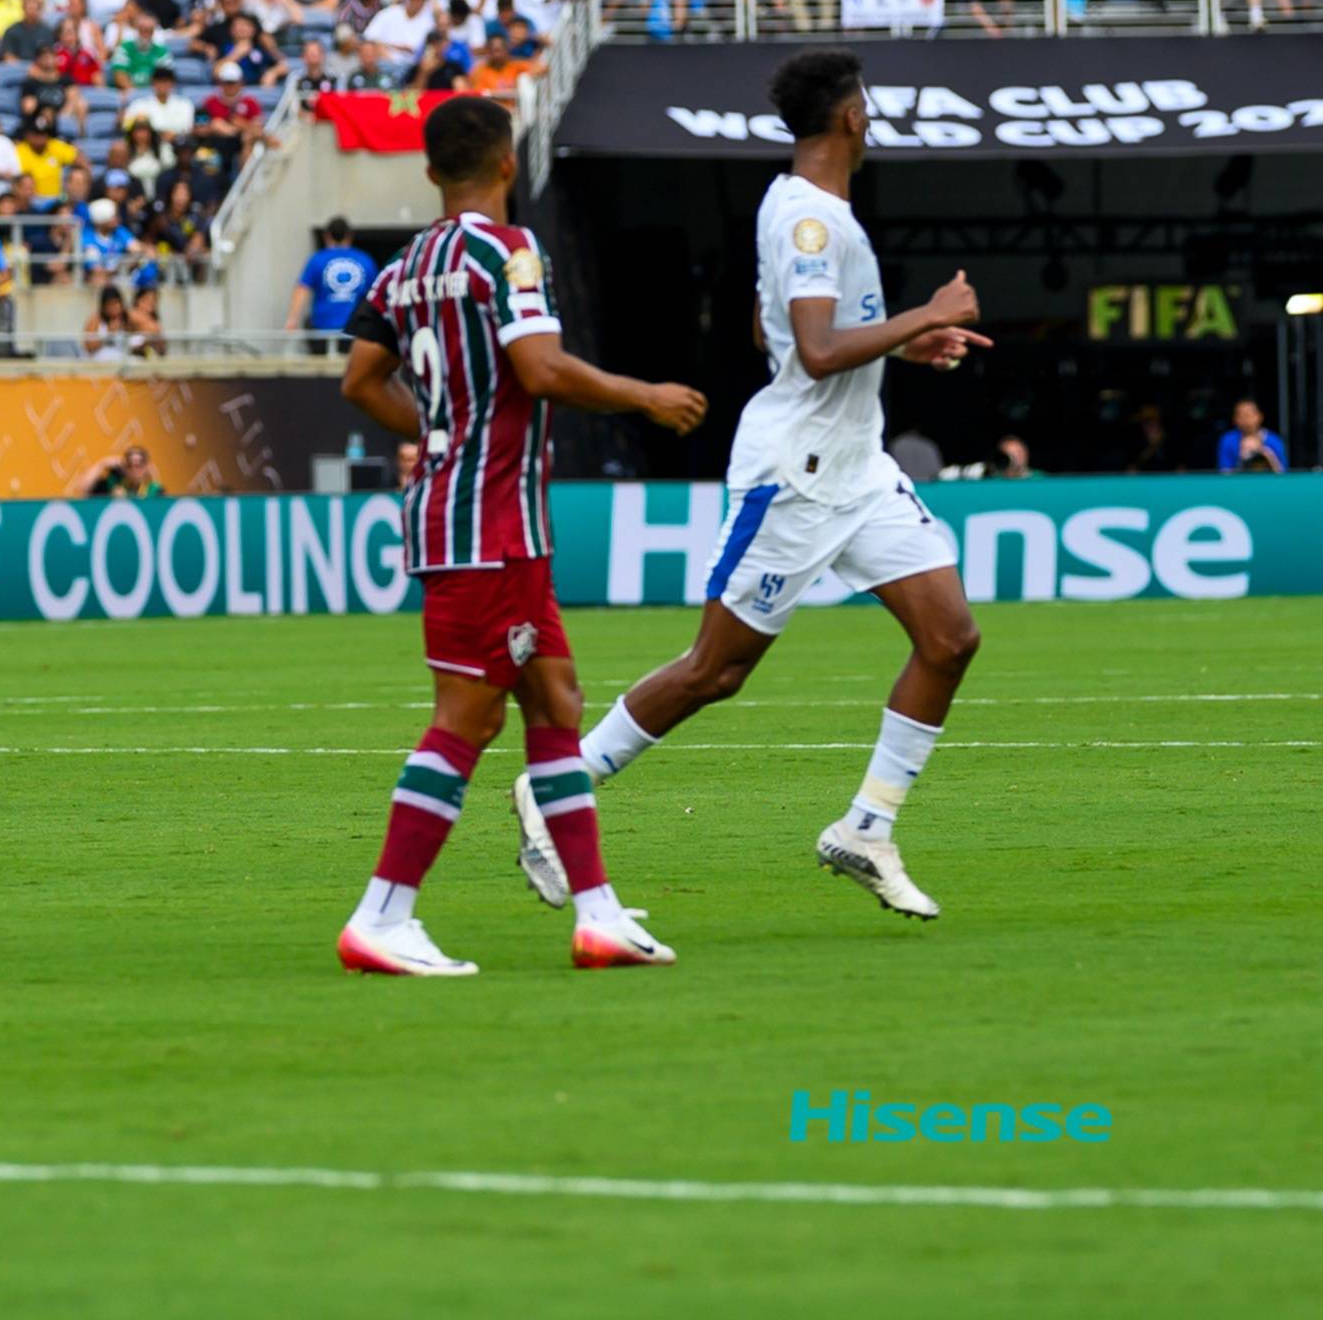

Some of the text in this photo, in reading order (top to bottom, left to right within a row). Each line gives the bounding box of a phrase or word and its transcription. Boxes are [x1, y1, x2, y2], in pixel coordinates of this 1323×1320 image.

[989, 80, 1208, 119] CLUB
[666, 106, 983, 147] WOLD
[995, 115, 1165, 146] CUP
[1088, 285, 1238, 340] FIFA
[28, 494, 411, 622] COOLING
